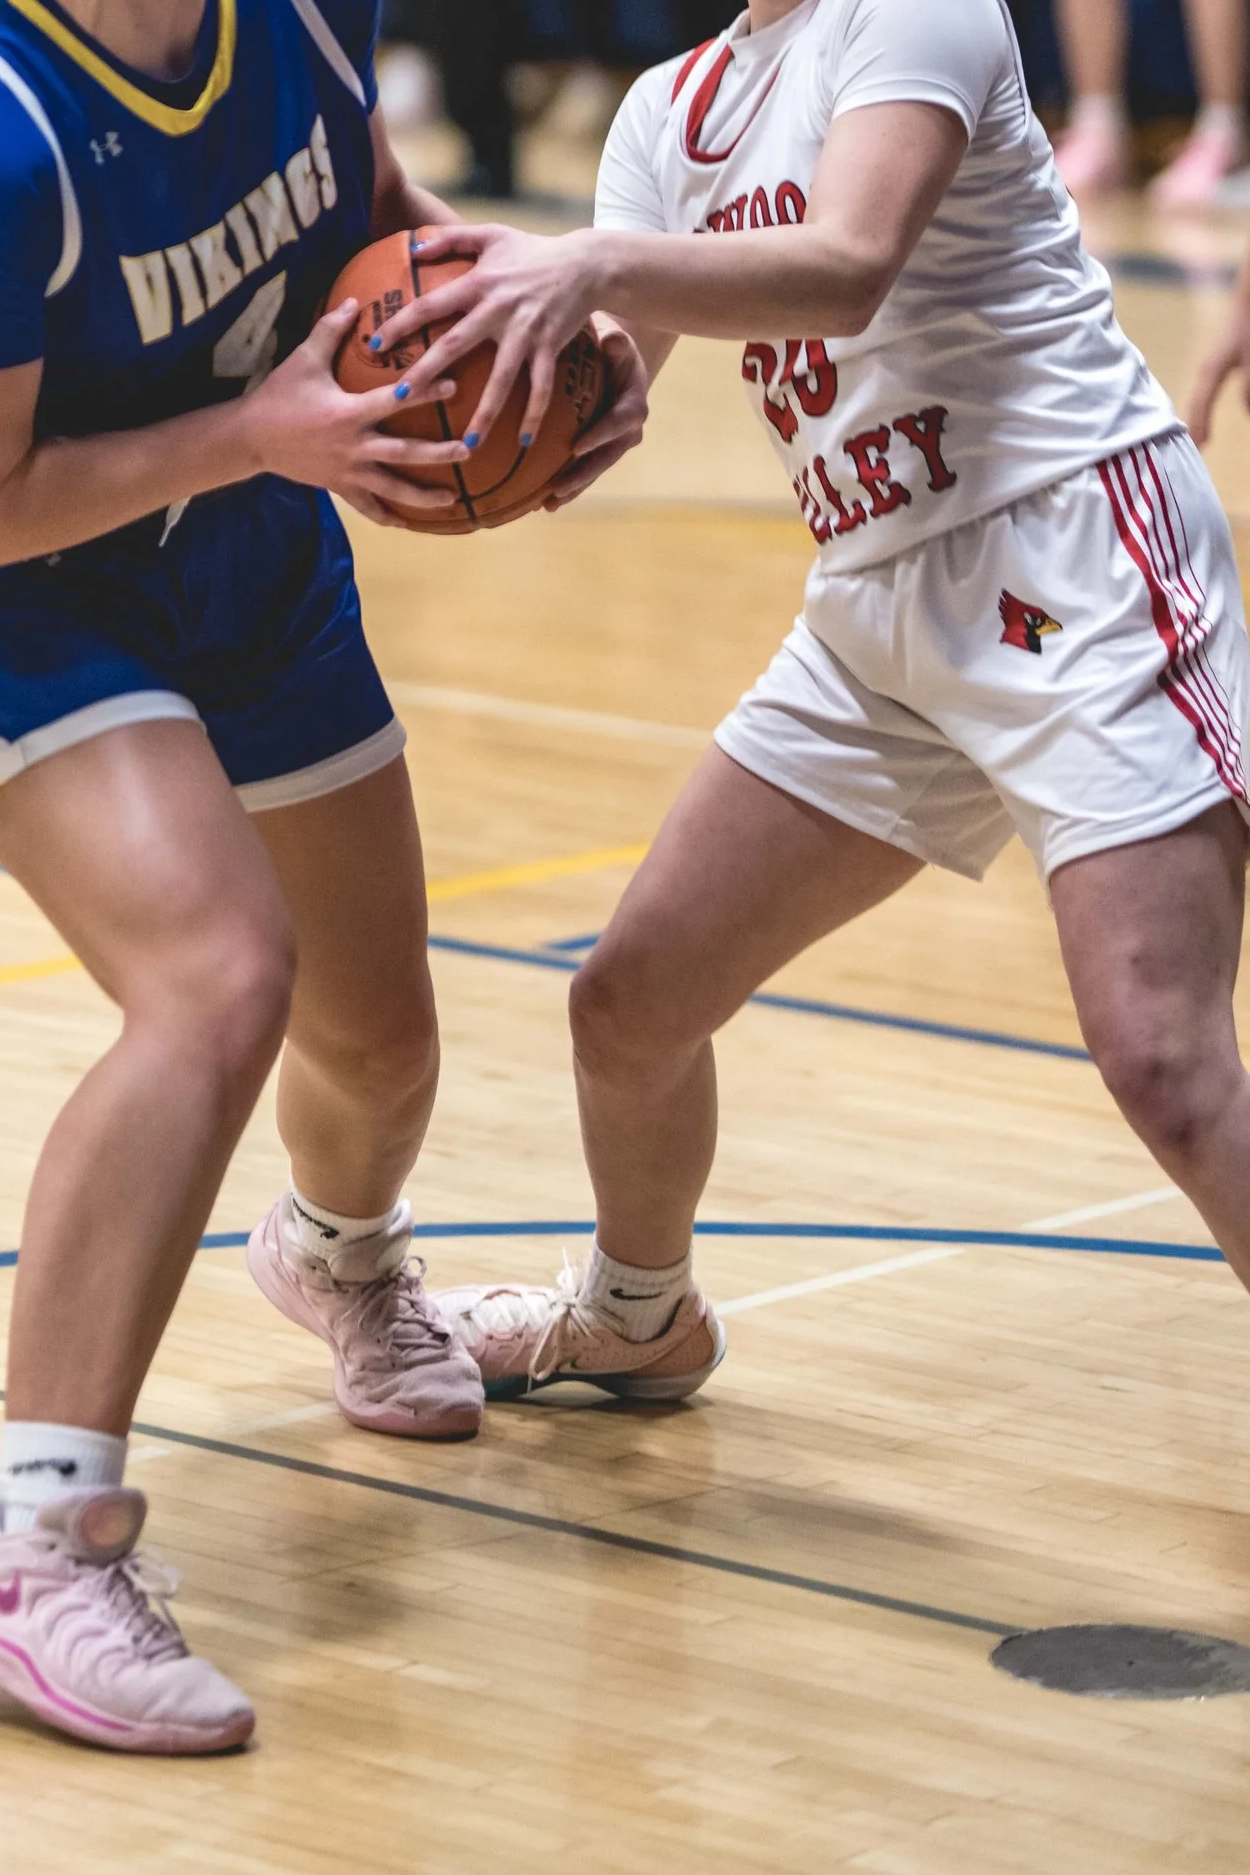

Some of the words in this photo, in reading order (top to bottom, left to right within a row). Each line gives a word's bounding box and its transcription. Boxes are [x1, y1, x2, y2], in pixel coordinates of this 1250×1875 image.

[118, 113, 338, 346] VIKINGS
[212, 269, 288, 396] 4
[741, 338, 839, 445] 20
